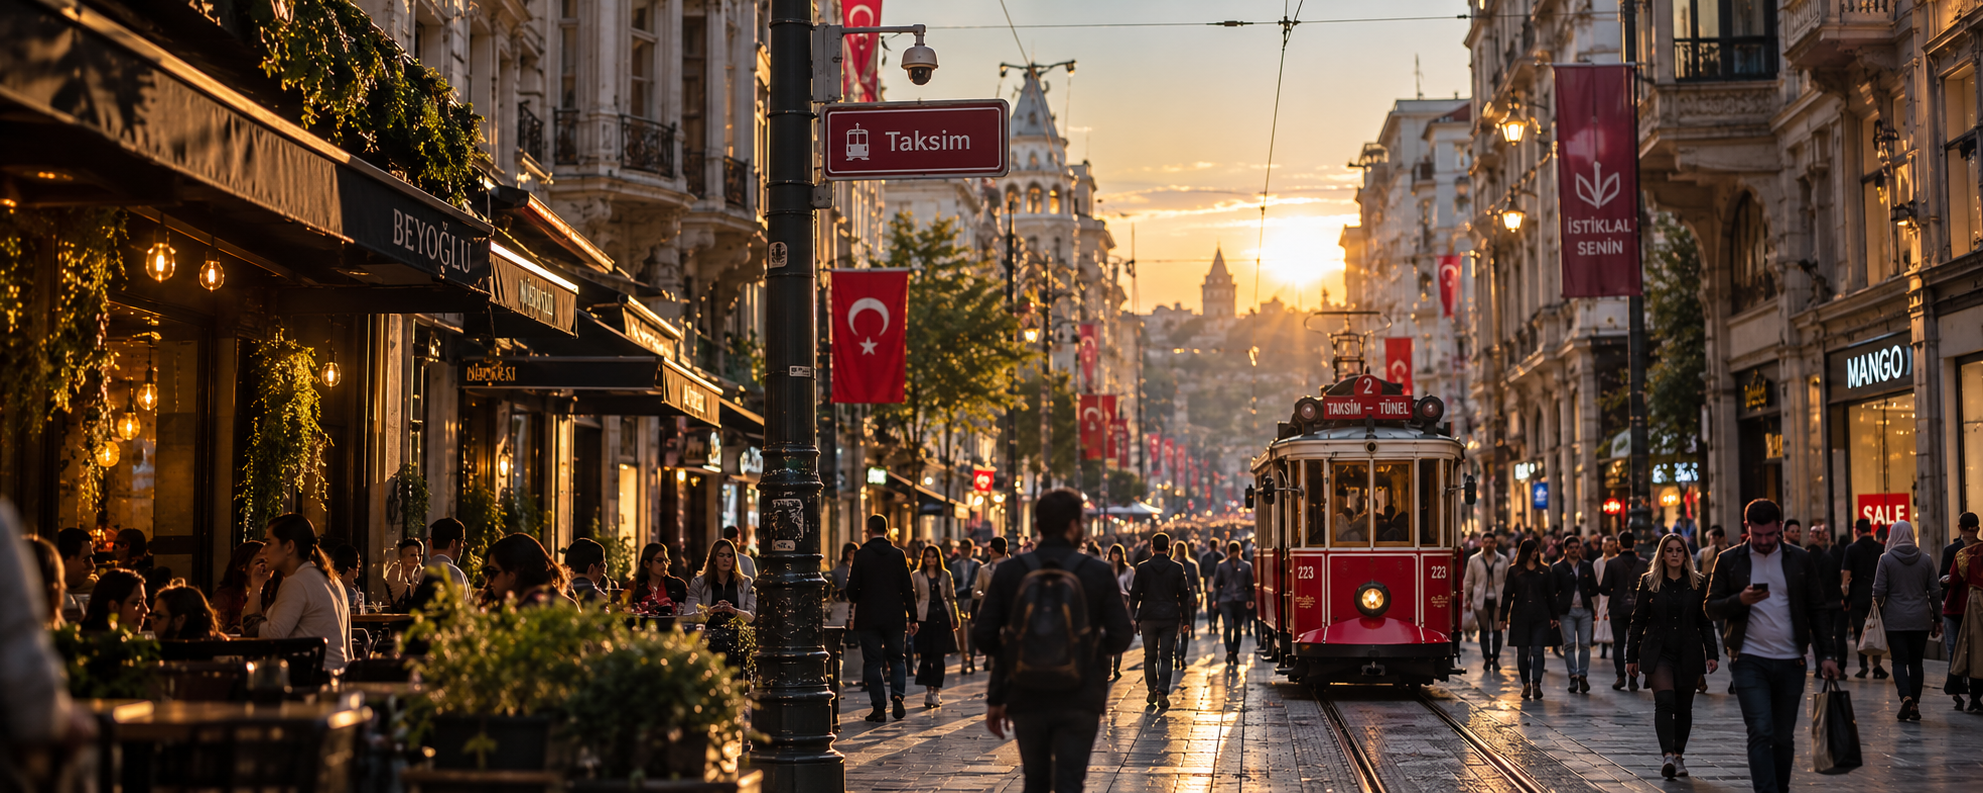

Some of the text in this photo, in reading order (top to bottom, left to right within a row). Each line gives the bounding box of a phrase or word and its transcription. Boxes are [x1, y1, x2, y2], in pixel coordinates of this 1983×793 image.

[885, 129, 970, 152] Taksim
[1567, 216, 1632, 234] İSTİKLAL
[393, 208, 471, 273] BEYOĞLU
[1577, 237, 1623, 256] SENİN
[1847, 344, 1903, 389] MANGO
[1363, 377, 1373, 394] 2
[1327, 399, 1362, 415] TAKSİM
[1379, 399, 1409, 415] TÜNEL
[1863, 505, 1905, 525] SALE
[1298, 566, 1314, 579] 223
[1431, 566, 1447, 579] 223
